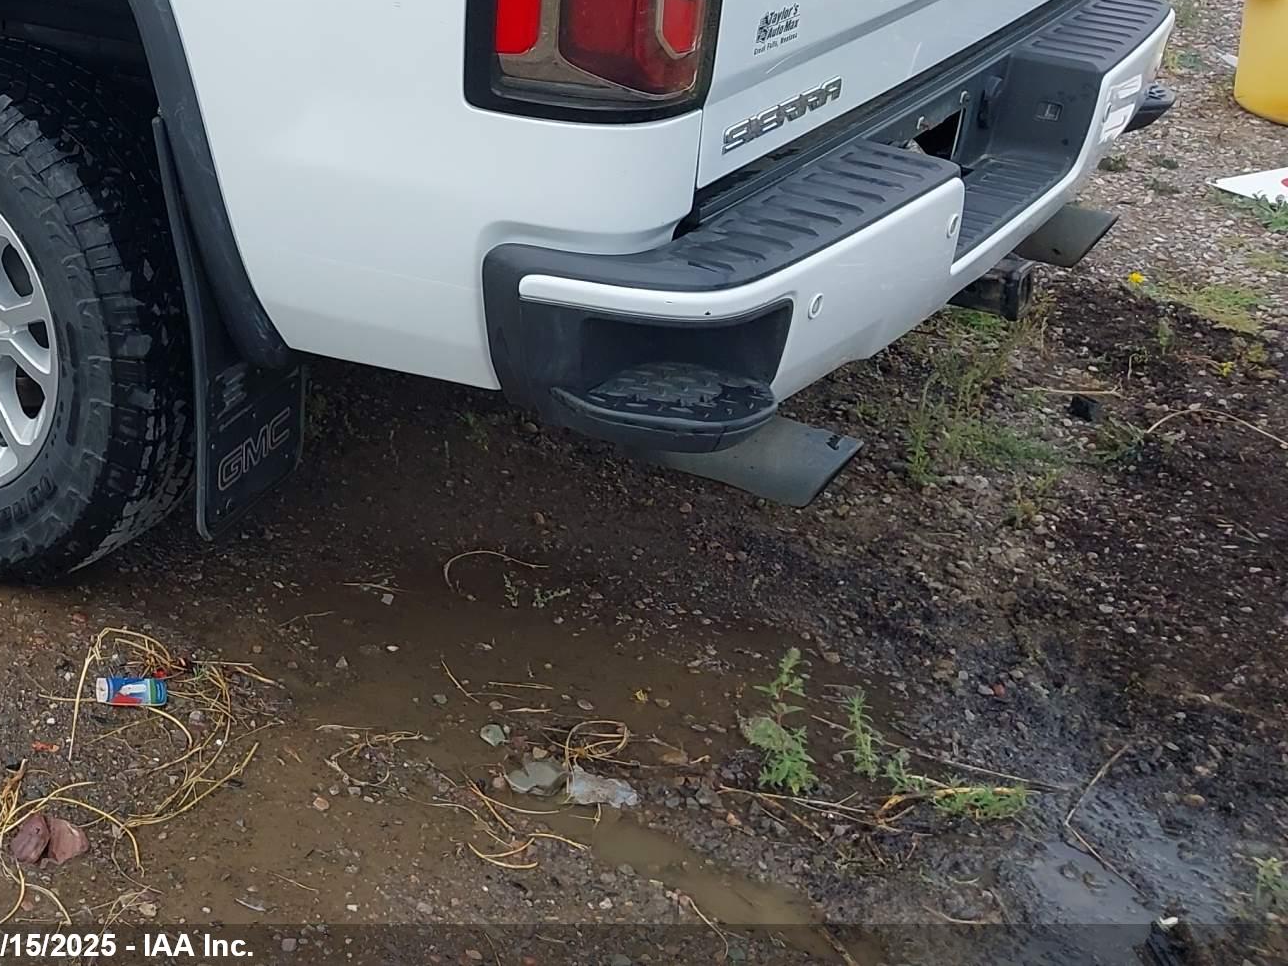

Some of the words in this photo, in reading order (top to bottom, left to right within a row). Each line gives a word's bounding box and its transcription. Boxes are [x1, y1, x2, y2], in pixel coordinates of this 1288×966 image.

[767, 3, 800, 25] Taylor's
[722, 75, 842, 155] SIERRA
[218, 406, 290, 491] GMC
